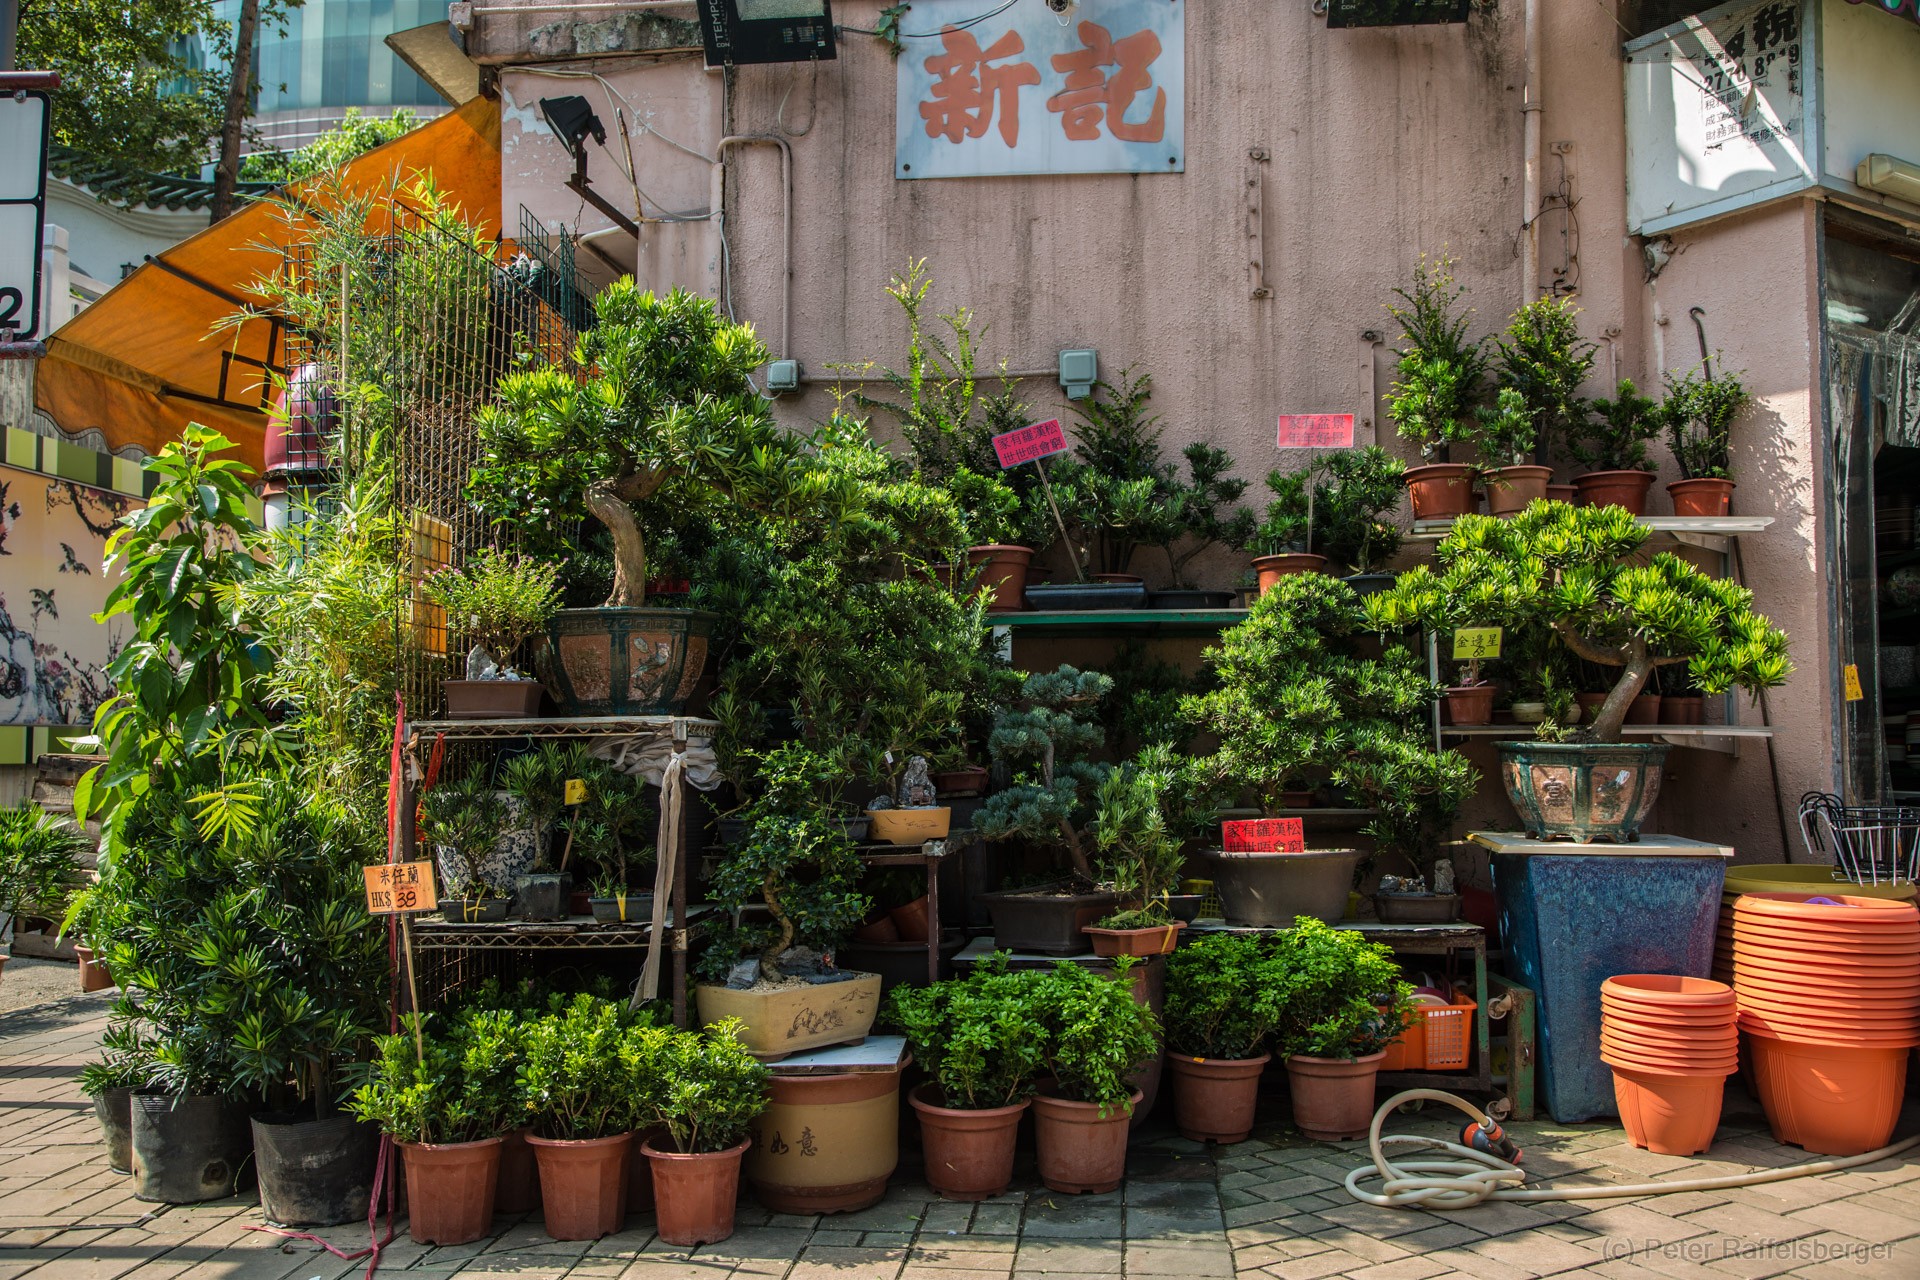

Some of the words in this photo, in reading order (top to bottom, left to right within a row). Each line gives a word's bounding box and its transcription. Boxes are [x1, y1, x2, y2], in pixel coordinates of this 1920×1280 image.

[919, 20, 1166, 148] 新記
[997, 421, 1058, 450] 家有羅漢松
[1227, 822, 1302, 839] 家有羅漢松
[380, 865, 419, 886] 米仔蘭
[371, 890, 392, 909] HK$
[396, 890, 417, 908] 38
